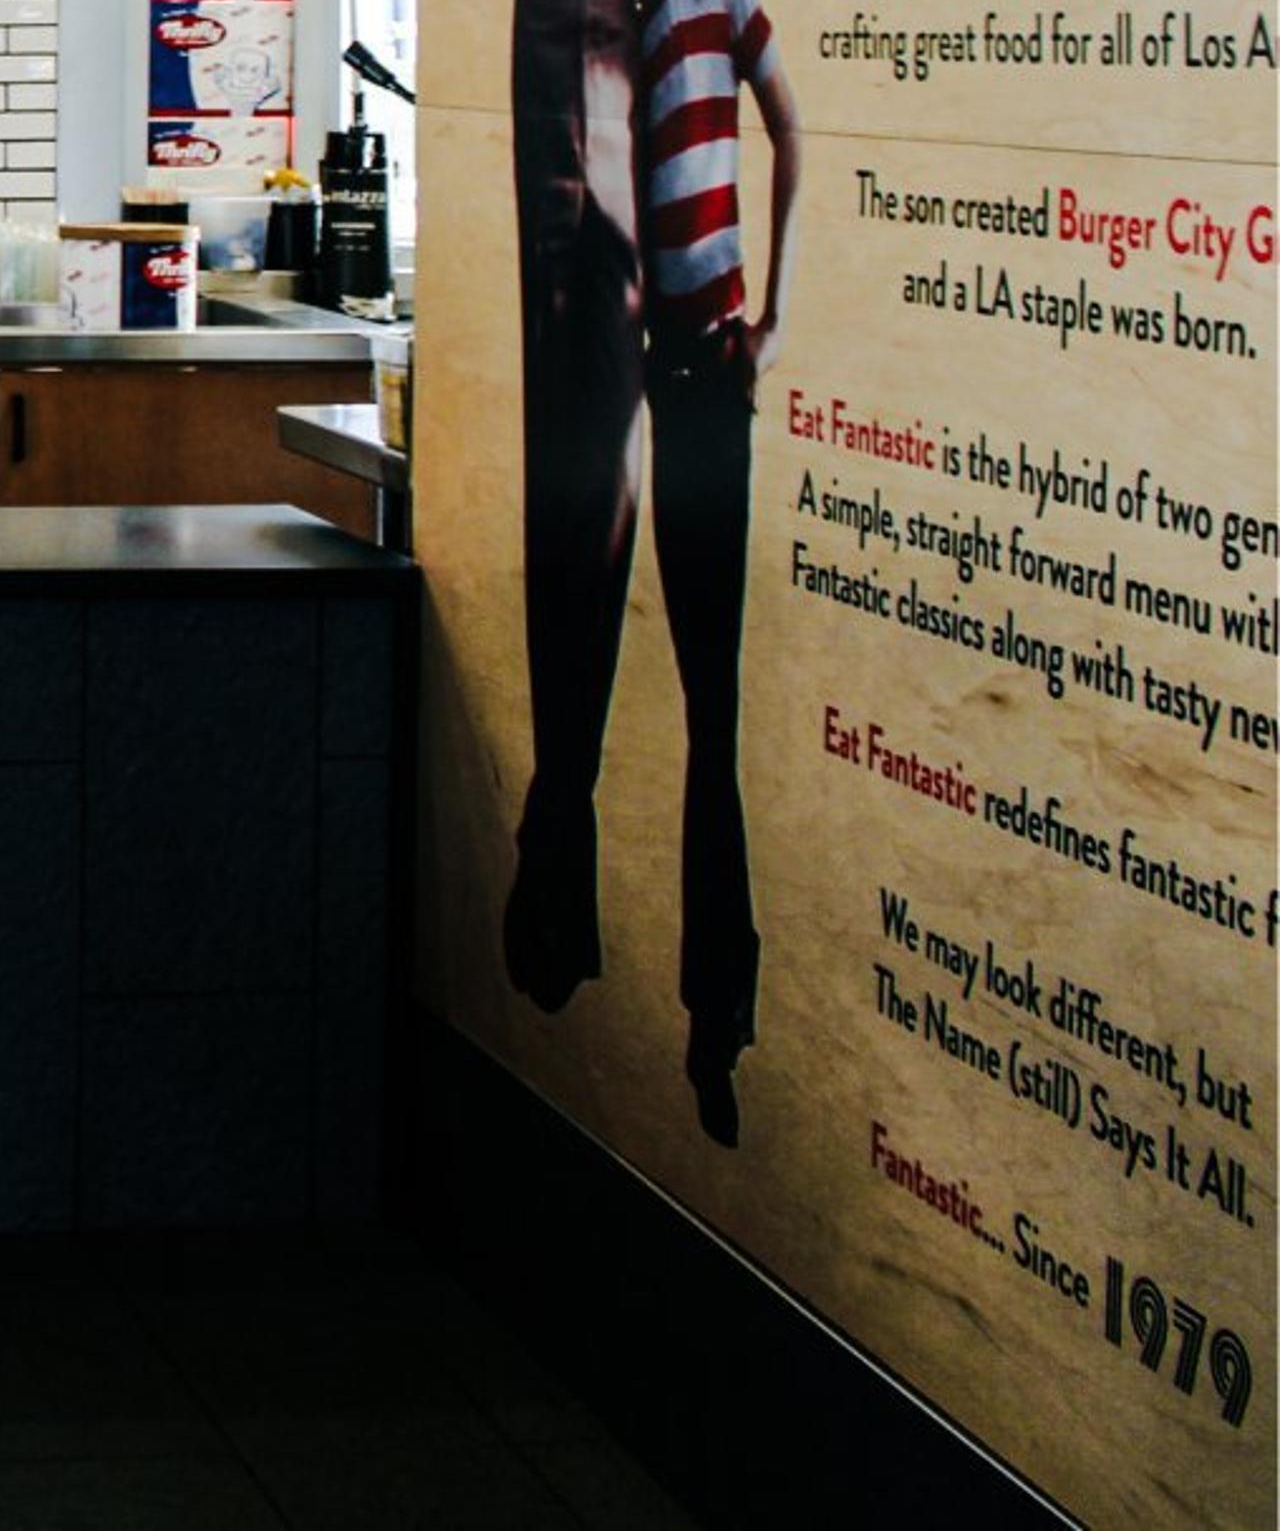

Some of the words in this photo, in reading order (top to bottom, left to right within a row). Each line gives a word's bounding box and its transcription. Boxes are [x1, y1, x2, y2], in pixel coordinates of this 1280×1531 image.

[820, 14, 908, 81] crafting
[914, 27, 977, 81] great
[985, 13, 1041, 63] food
[1052, 13, 1092, 64] for
[1101, 13, 1132, 65] all
[1142, 13, 1177, 65] of
[1184, 13, 1236, 68] Los
[856, 170, 899, 221] The
[903, 194, 944, 226] son
[952, 187, 1049, 237] created
[1058, 188, 1156, 269] Burger
[1166, 198, 1235, 280] City
[903, 260, 947, 308] and
[954, 281, 966, 311] a
[976, 265, 1015, 319] LA
[1022, 279, 1103, 349] staple
[1111, 301, 1165, 343] was
[1174, 293, 1257, 359] born.
[788, 389, 825, 443] Eat
[830, 400, 936, 470] Fantastic
[942, 428, 962, 476] is
[968, 434, 1012, 489] the
[1019, 442, 1108, 518] hybrid
[1117, 470, 1150, 523] of
[1156, 489, 1213, 539] two
[797, 471, 818, 517] A
[823, 479, 901, 552] simple,
[906, 512, 1002, 584] straight
[1009, 527, 1117, 607] forward
[1125, 575, 1212, 635] menu
[791, 541, 892, 619] Fantastic
[896, 579, 986, 652] classics
[992, 611, 1065, 700] along
[1072, 640, 1135, 703] with
[1144, 670, 1222, 752] tasty
[1231, 703, 1278, 755] ne
[824, 706, 861, 765] Eat
[867, 723, 977, 815] Fantastic
[985, 787, 1112, 875] redefines
[1119, 829, 1257, 937] fantastic
[873, 963, 917, 1032] The
[924, 992, 1002, 1082] Name
[1008, 1041, 1081, 1130] (still)
[1090, 1084, 1157, 1178] Says
[1167, 1125, 1191, 1191] It
[1197, 1149, 1255, 1228] All.
[881, 888, 919, 953] We
[925, 929, 979, 999] may
[985, 940, 1041, 1018] look
[1048, 978, 1188, 1106] different,
[1197, 1048, 1253, 1130] but
[870, 1119, 1006, 1254] Fantastic...
[1013, 1212, 1091, 1309] Since
[1104, 1254, 1253, 1429] 1979
